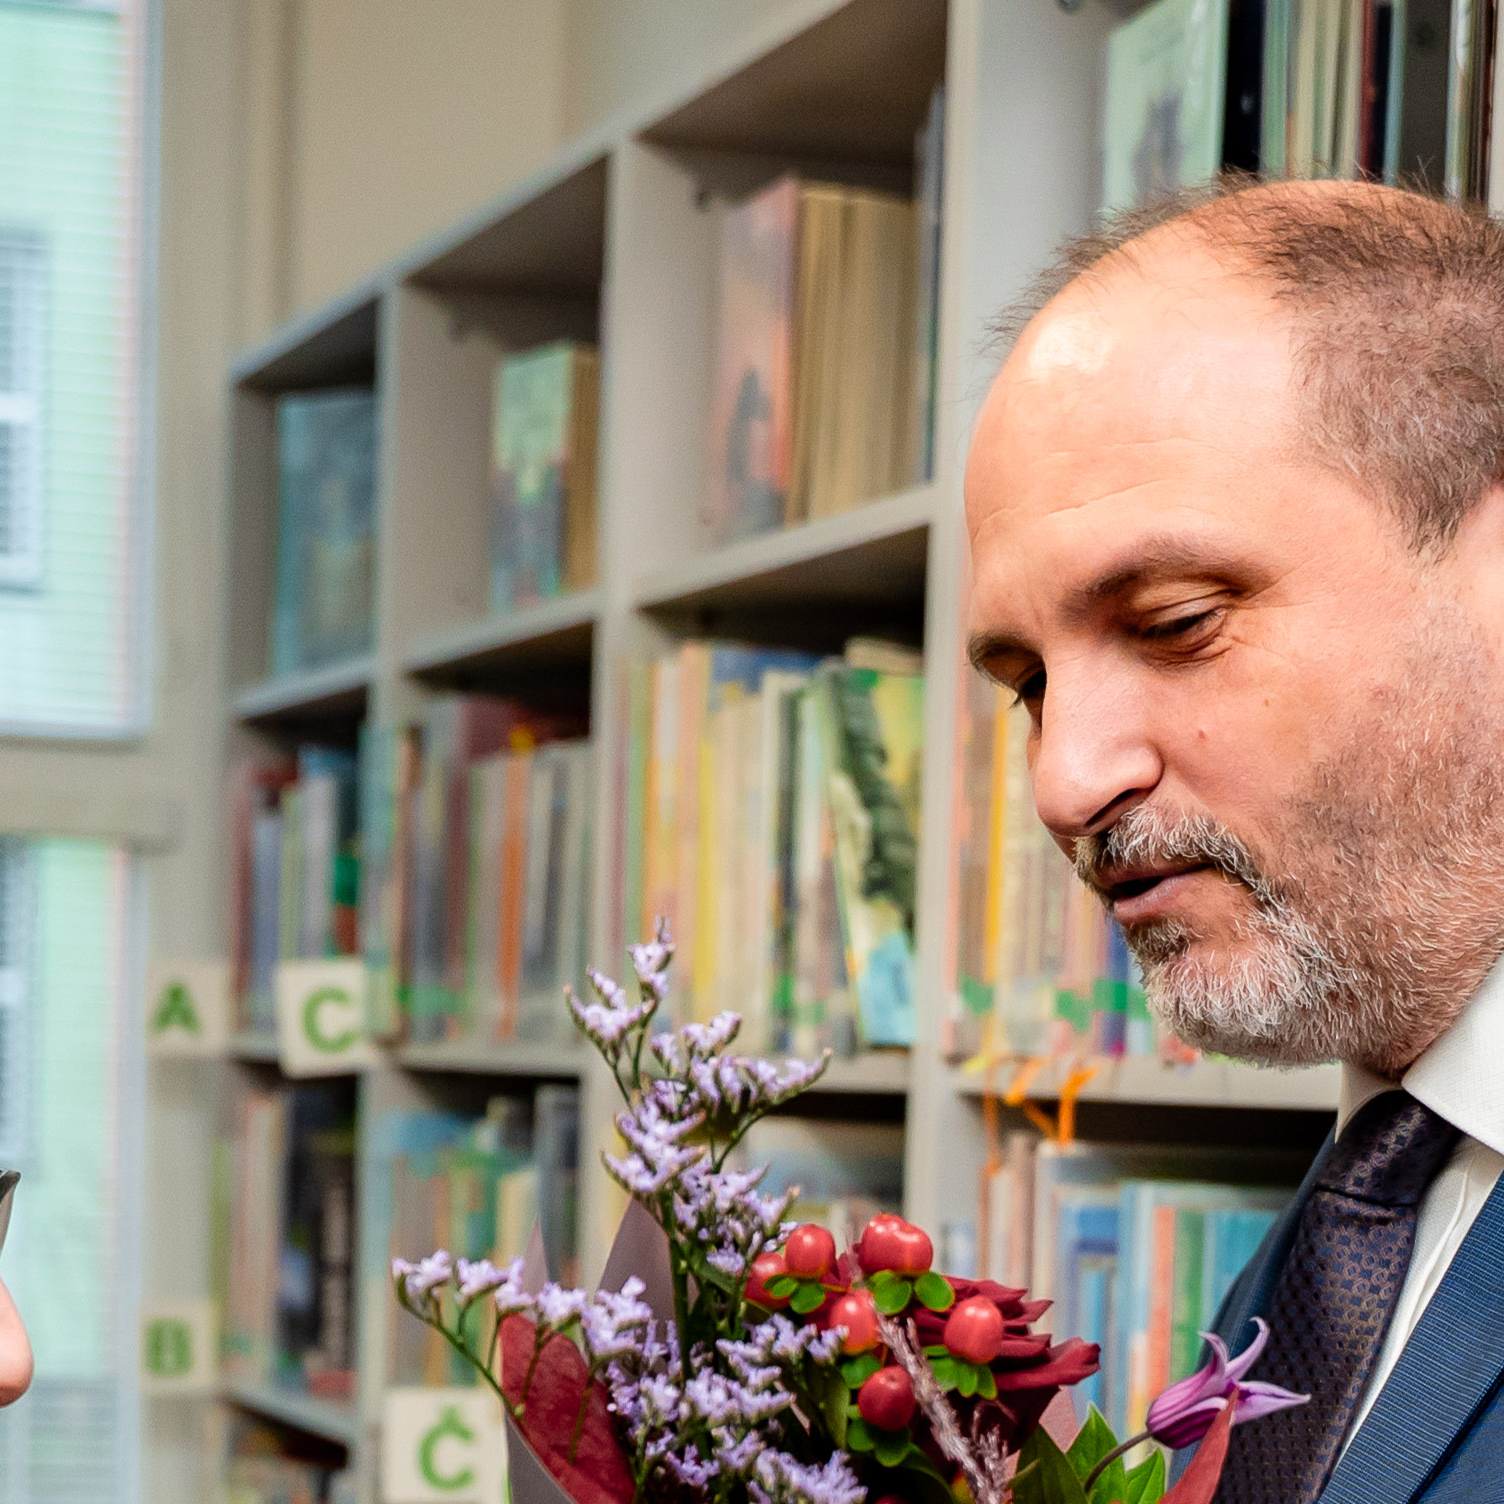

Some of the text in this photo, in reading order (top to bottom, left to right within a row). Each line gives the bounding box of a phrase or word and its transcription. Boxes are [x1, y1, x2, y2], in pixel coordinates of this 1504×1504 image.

[152, 982, 200, 1035] A
[301, 986, 360, 1054] C
[145, 1318, 193, 1376] B
